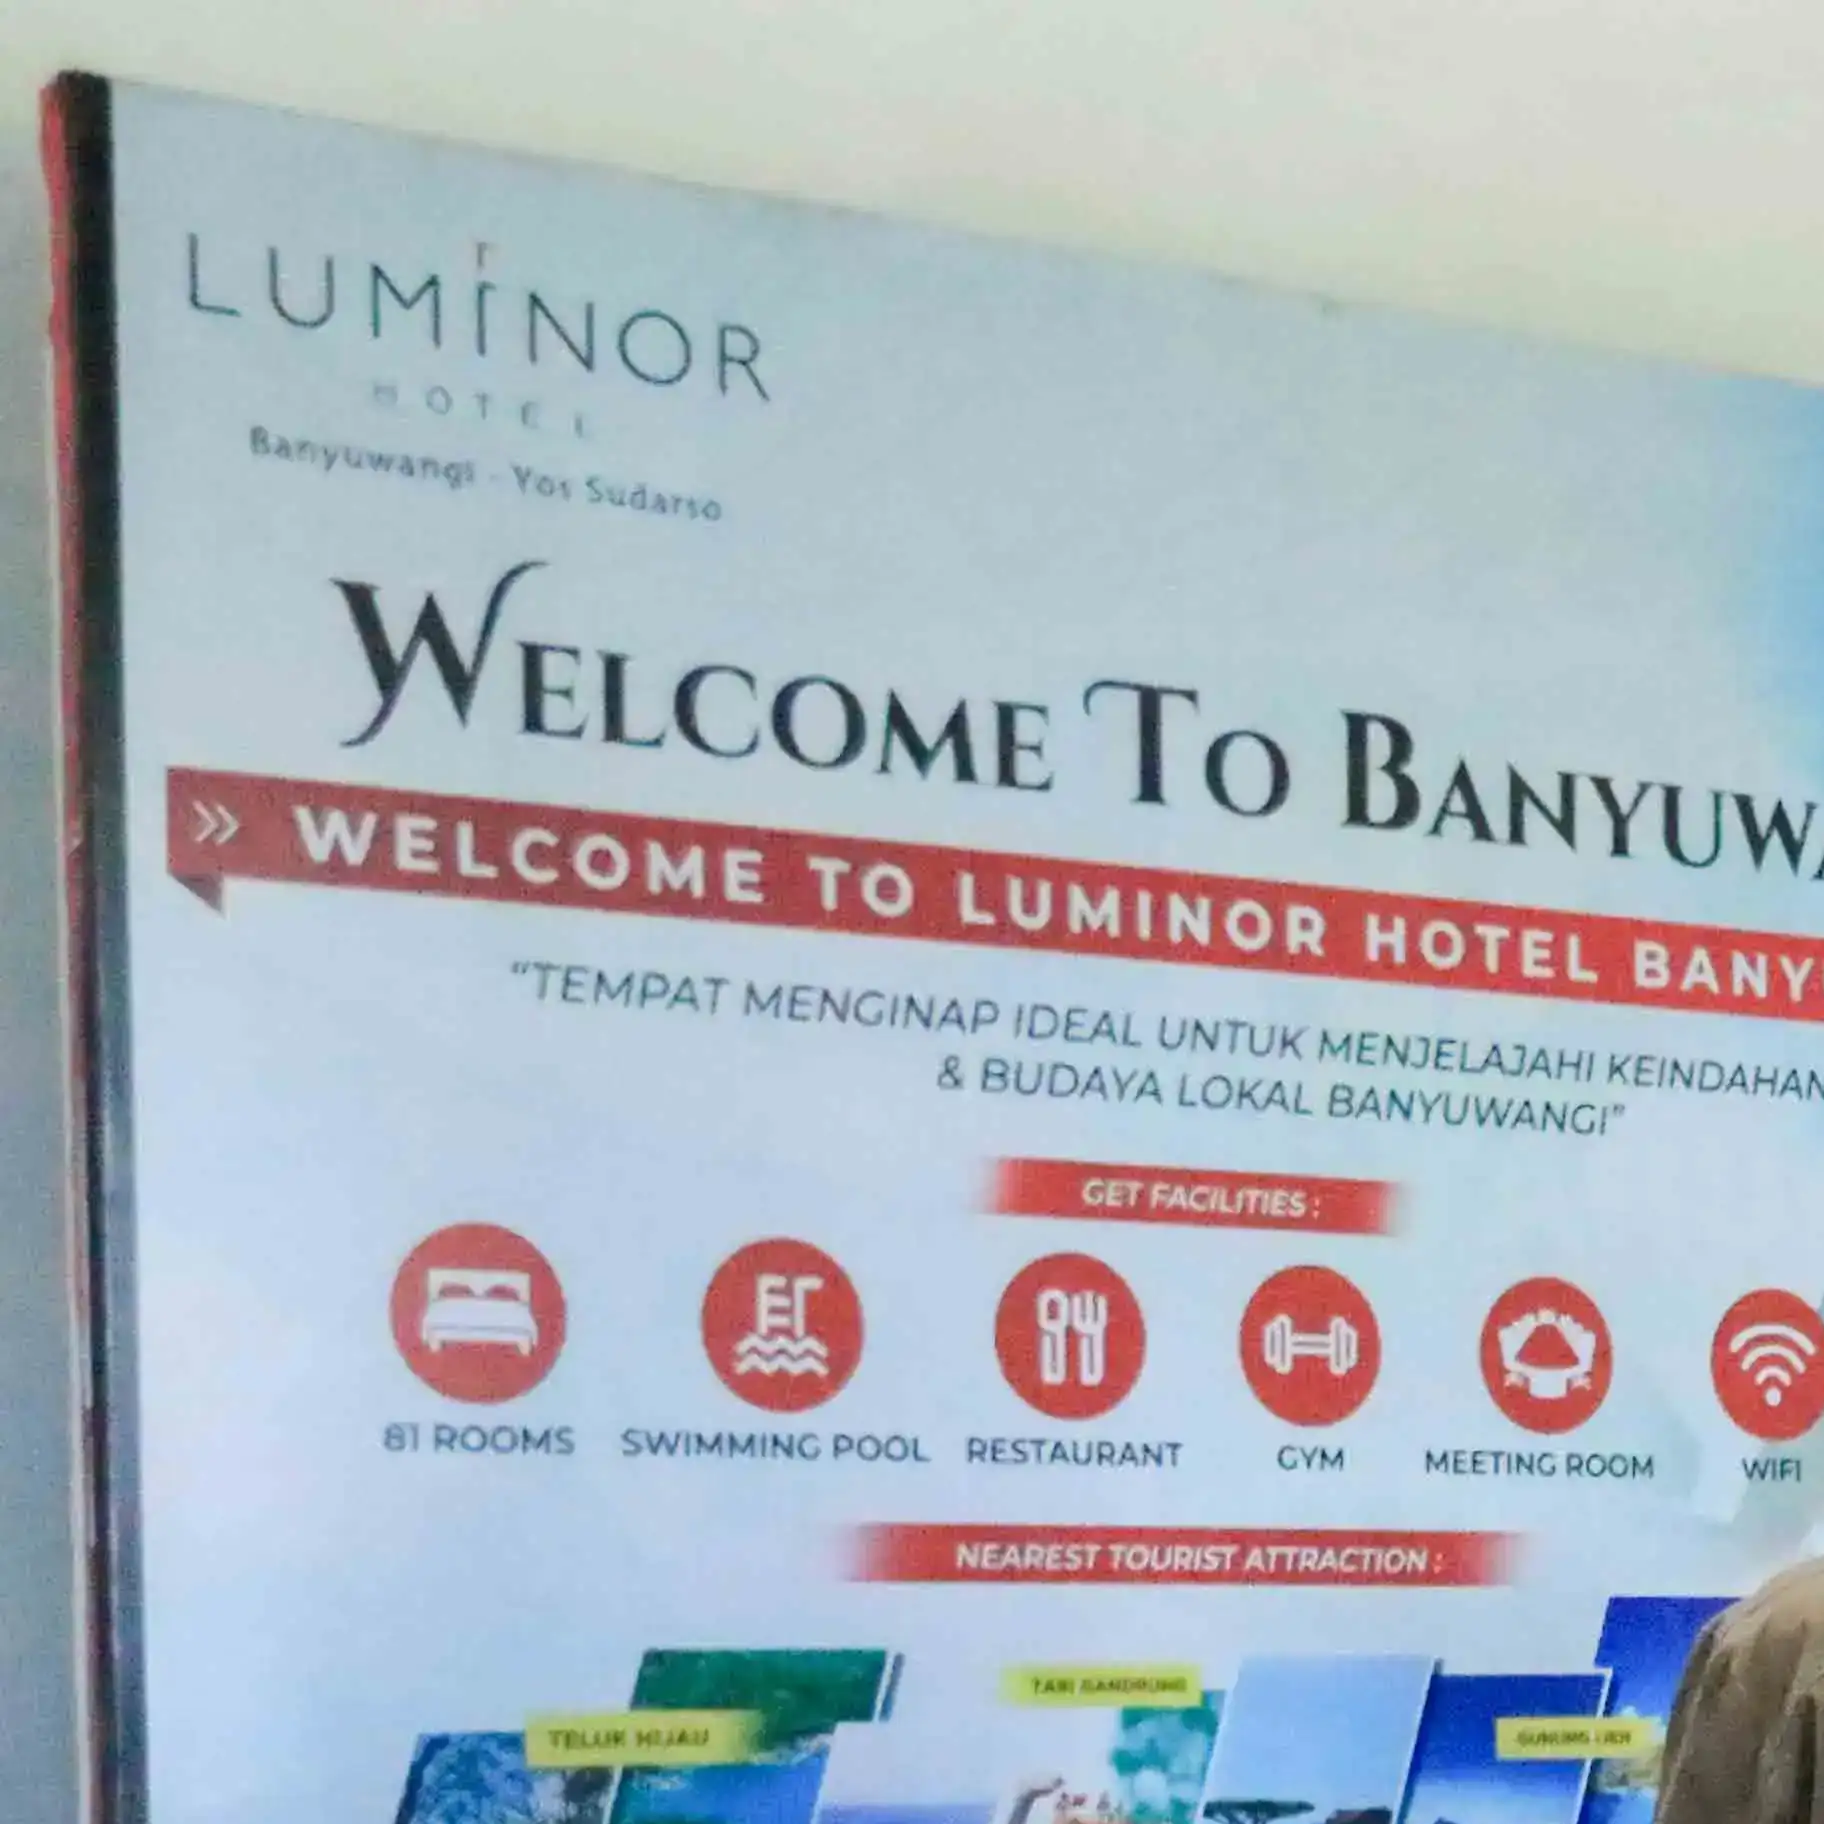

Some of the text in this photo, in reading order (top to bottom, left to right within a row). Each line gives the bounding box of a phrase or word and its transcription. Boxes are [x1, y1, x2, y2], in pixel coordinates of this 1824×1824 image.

[189, 233, 769, 401] LUMINOR
[250, 426, 476, 490] Banyuwangi
[511, 463, 573, 501] Yos
[586, 477, 723, 522] Sudarso
[294, 804, 767, 905] WELCOME
[811, 857, 914, 919] TO
[958, 873, 1325, 956] LUMINOR
[1365, 916, 1599, 984] HOTEL
[742, 980, 1000, 1036] MENGINAP
[1012, 1003, 1143, 1050] IDEAL
[1159, 1015, 1311, 1060] UNTUK
[1317, 1031, 1596, 1083] MENJELAJAHI
[937, 1053, 965, 1090] &
[980, 1058, 1163, 1105] BUDAYA
[1178, 1072, 1322, 1117] LOKAL
[1082, 1178, 1140, 1208] GET
[383, 1423, 577, 1455] 81 ROOMS
[622, 1430, 931, 1464] SWIMMING POOL
[967, 1437, 1183, 1468] RESTAURANT
[1276, 1445, 1345, 1472] GYM
[1425, 1451, 1655, 1480] MEETING ROOM
[1741, 1458, 1803, 1483] WIFI
[956, 1543, 1099, 1572] NEAREST
[1109, 1543, 1235, 1573] TOURIST
[549, 1727, 626, 1749] TELUK
